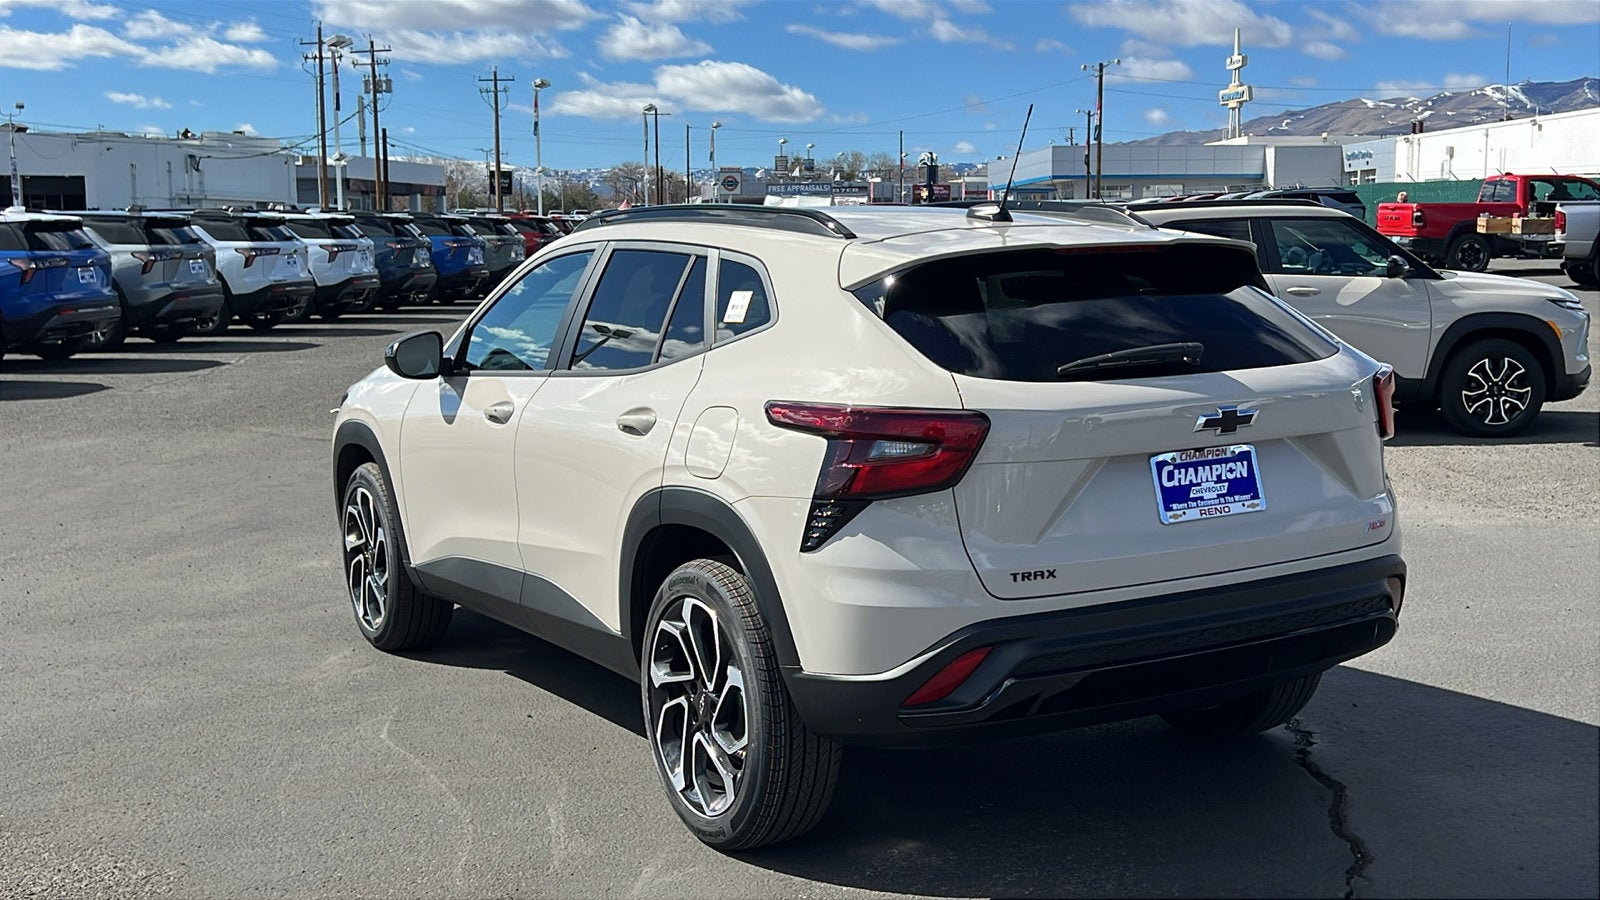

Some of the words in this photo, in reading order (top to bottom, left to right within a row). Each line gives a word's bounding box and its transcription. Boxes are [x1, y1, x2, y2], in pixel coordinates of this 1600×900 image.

[1180, 448, 1227, 461] CHAMPION
[1162, 461, 1247, 487] CHAMPION
[1192, 486, 1225, 495] CHEVROLET
[1199, 506, 1231, 517] RENO
[1010, 569, 1056, 582] TRAX
